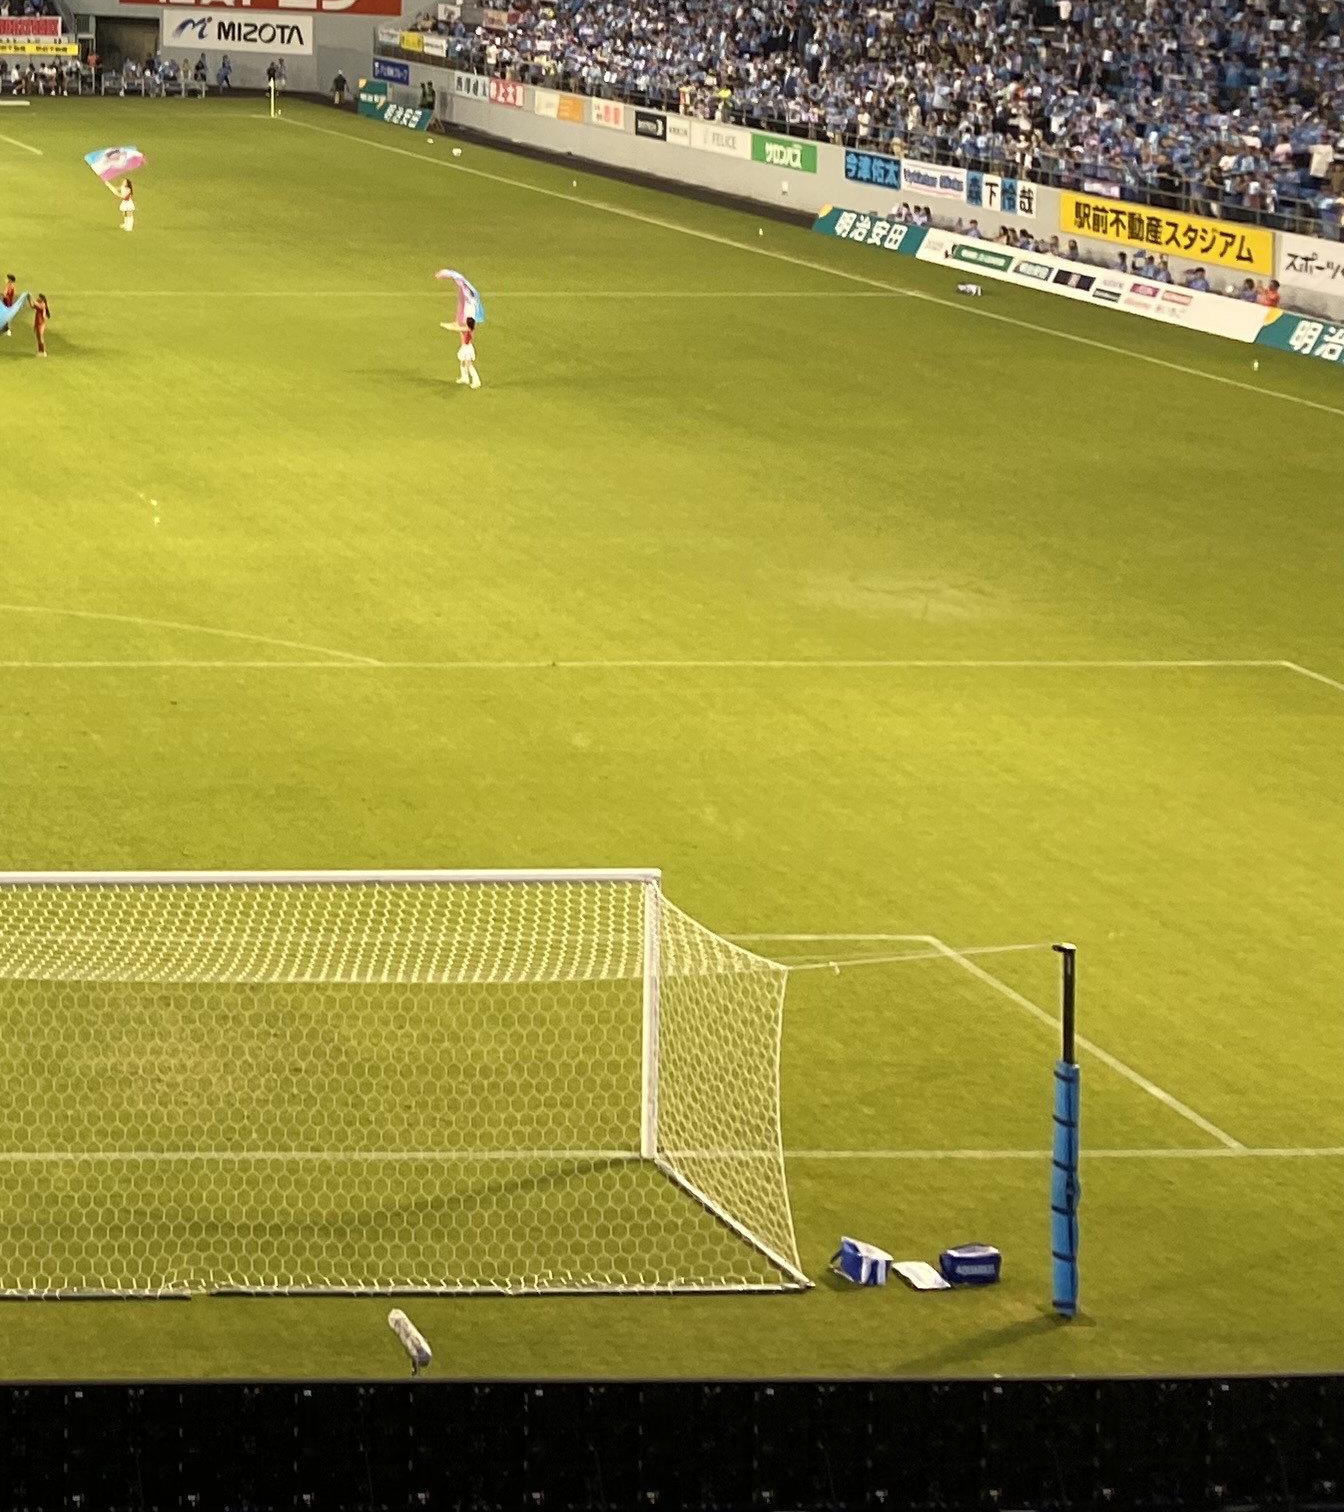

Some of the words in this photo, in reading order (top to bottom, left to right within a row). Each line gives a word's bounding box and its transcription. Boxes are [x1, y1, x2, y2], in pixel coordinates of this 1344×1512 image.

[218, 21, 304, 45] MIZOTA
[834, 211, 908, 251] 明治安田
[1074, 201, 1254, 263] 駅前不動産スタジアム
